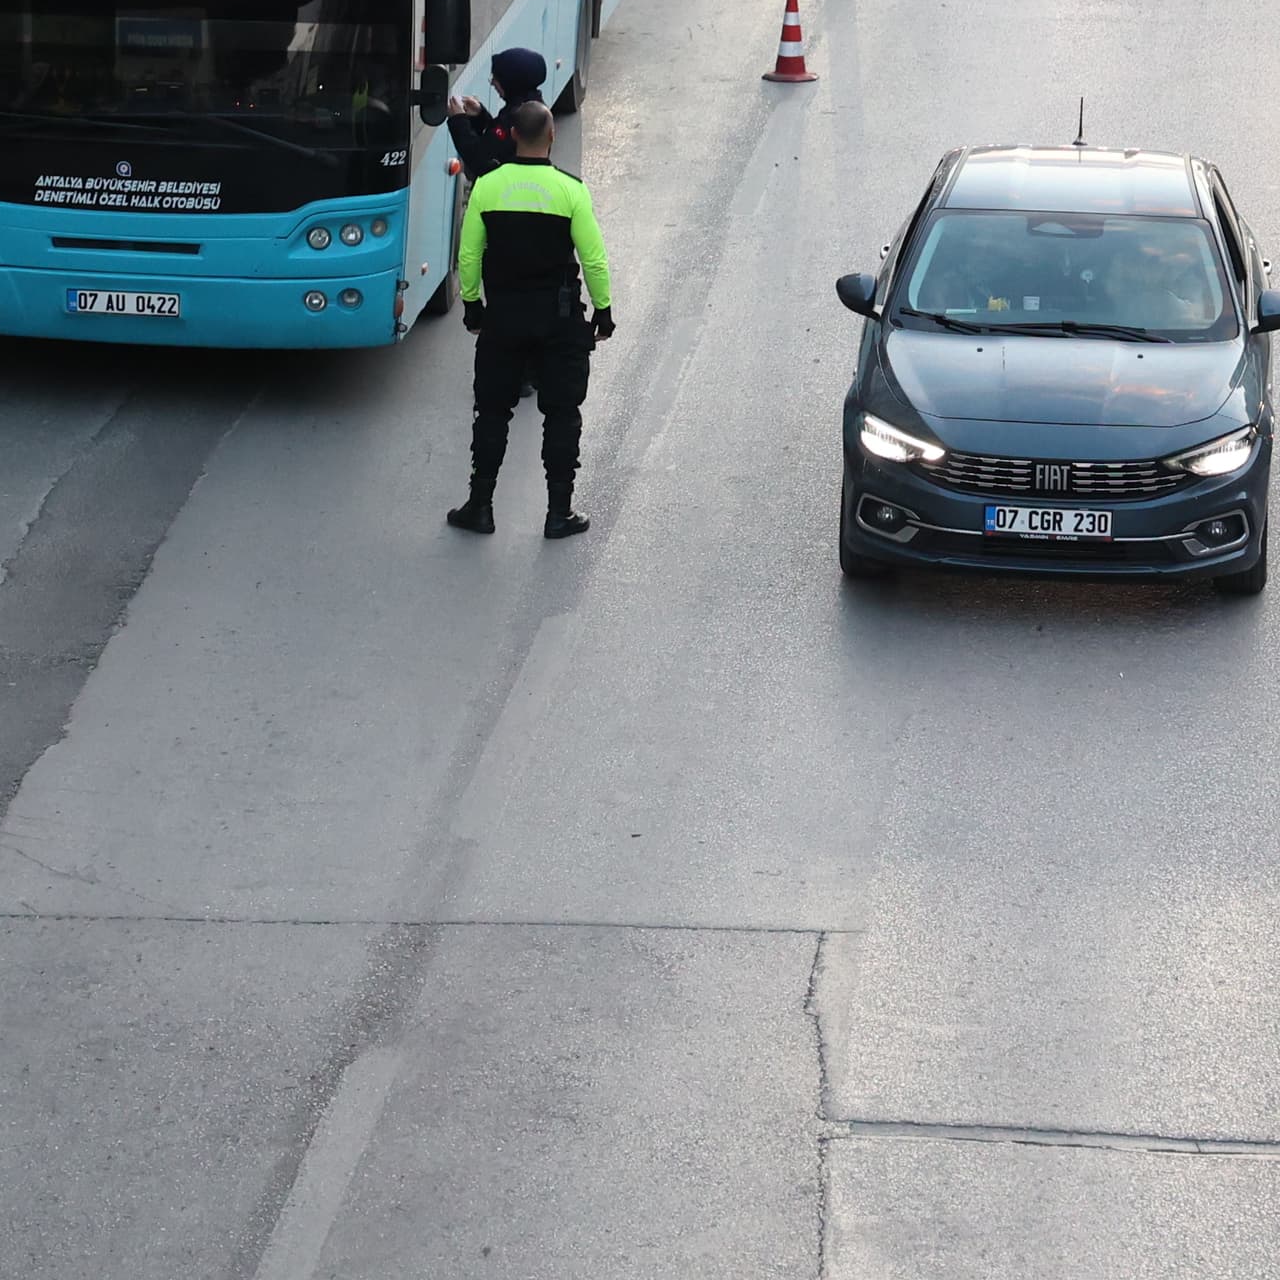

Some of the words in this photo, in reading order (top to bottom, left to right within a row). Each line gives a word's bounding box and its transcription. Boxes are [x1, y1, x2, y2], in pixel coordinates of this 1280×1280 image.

[379, 150, 407, 166] 422
[34, 175, 83, 189] ANTALYA
[85, 177, 156, 193] BÜYÜKŞEHİR
[158, 181, 221, 195] BELEDİYESİ
[34, 190, 98, 204] DENETİMLİ
[98, 192, 129, 206] ÖZEL
[130, 195, 161, 208] HALK
[162, 196, 221, 210] OTOBÜSÜ
[78, 292, 98, 310] 07
[106, 294, 126, 312] AU
[136, 295, 177, 314] 0422
[1035, 464, 1071, 491] FIAT
[996, 508, 1019, 529] 07
[1028, 510, 1063, 532] CGR
[1073, 512, 1109, 534] 230
